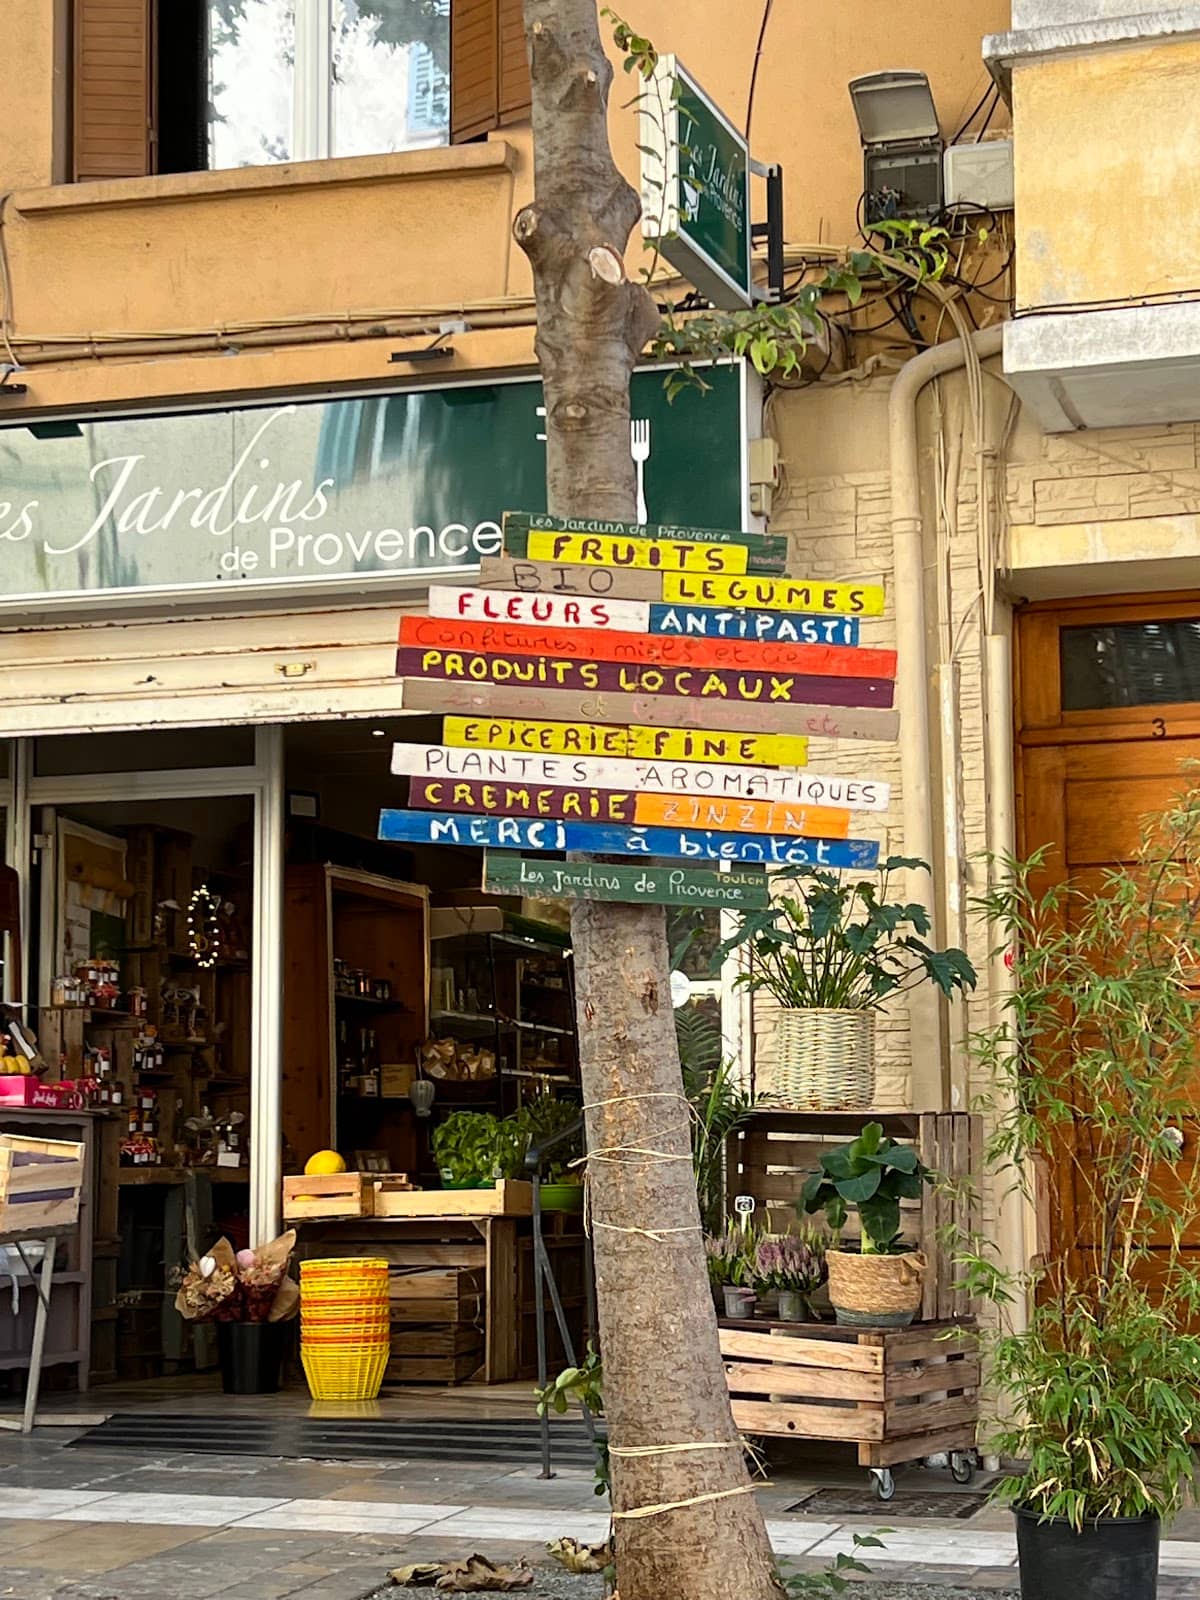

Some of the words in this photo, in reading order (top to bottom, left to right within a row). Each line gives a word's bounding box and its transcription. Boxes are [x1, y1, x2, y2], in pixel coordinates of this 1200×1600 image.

[0, 500, 39, 541] es
[44, 405, 335, 555] Jardins
[220, 545, 258, 573] de
[269, 520, 502, 569] Provence
[513, 563, 614, 593] BIO
[458, 592, 610, 624] FLEURS
[680, 578, 865, 612] LEGUMES
[619, 667, 794, 700] LOCAUX
[580, 695, 610, 718] et
[1151, 717, 1167, 738] 3
[425, 749, 588, 782] PLANTES
[643, 765, 877, 804] AROMATIQUES
[520, 862, 545, 883] Les
[552, 867, 621, 892] Jardins
[634, 873, 657, 893] de
[669, 870, 745, 900] Provence
